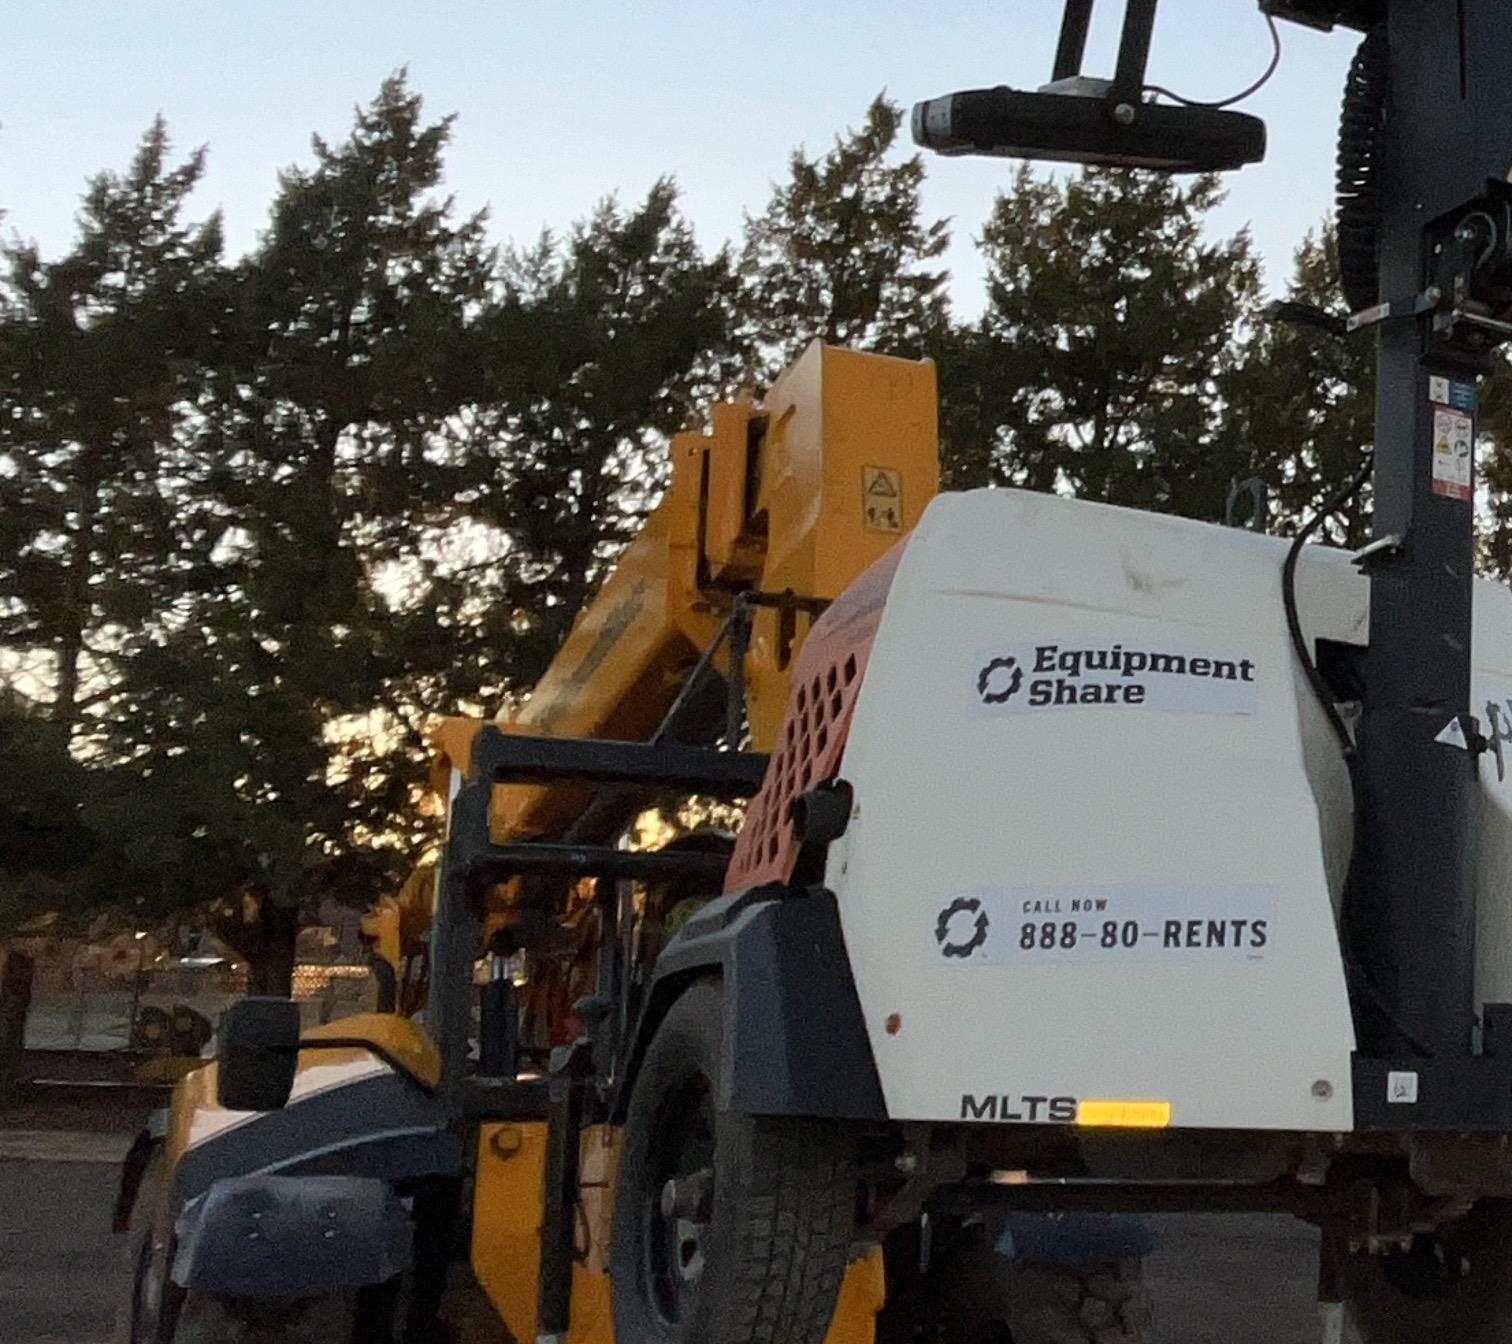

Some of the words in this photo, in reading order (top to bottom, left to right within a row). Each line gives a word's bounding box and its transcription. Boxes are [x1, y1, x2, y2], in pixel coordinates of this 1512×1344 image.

[1032, 644, 1256, 682] Equipment
[1028, 678, 1147, 706] Share
[1022, 899, 1062, 914] CALL
[1071, 898, 1108, 912] NOW
[1019, 919, 1268, 950] 888-80-RENTS
[961, 1094, 1077, 1122] MLTS
